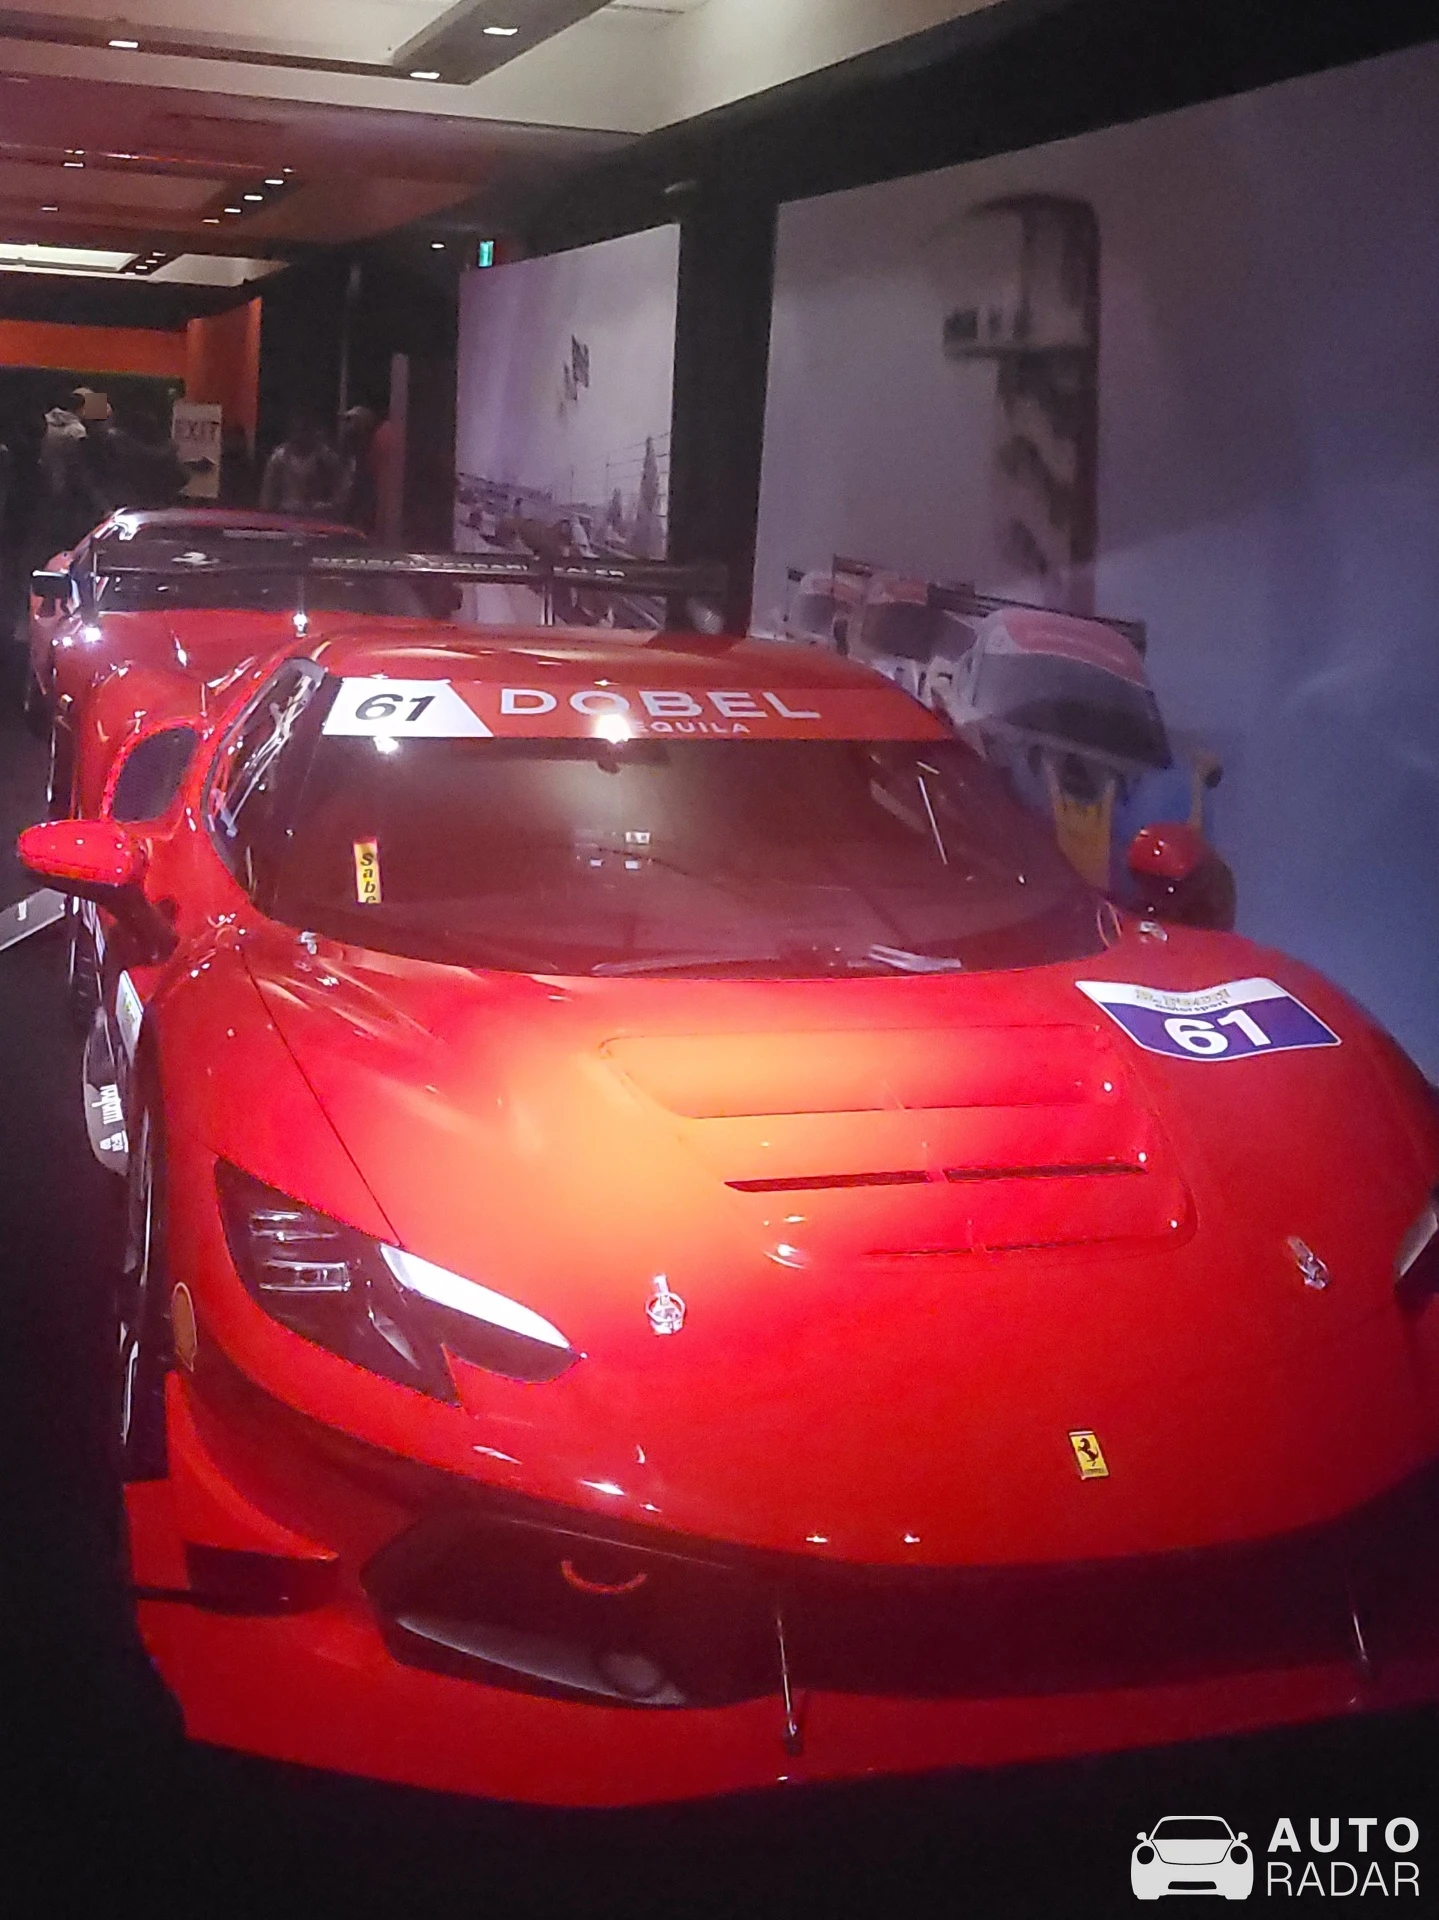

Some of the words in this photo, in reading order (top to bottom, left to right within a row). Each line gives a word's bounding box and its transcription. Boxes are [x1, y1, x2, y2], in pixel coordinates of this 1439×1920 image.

[174, 419, 220, 441] EXIT
[354, 693, 439, 722] 61
[501, 687, 822, 720] DOBEL
[631, 721, 751, 734] EQUILA
[1164, 1009, 1272, 1055] 61
